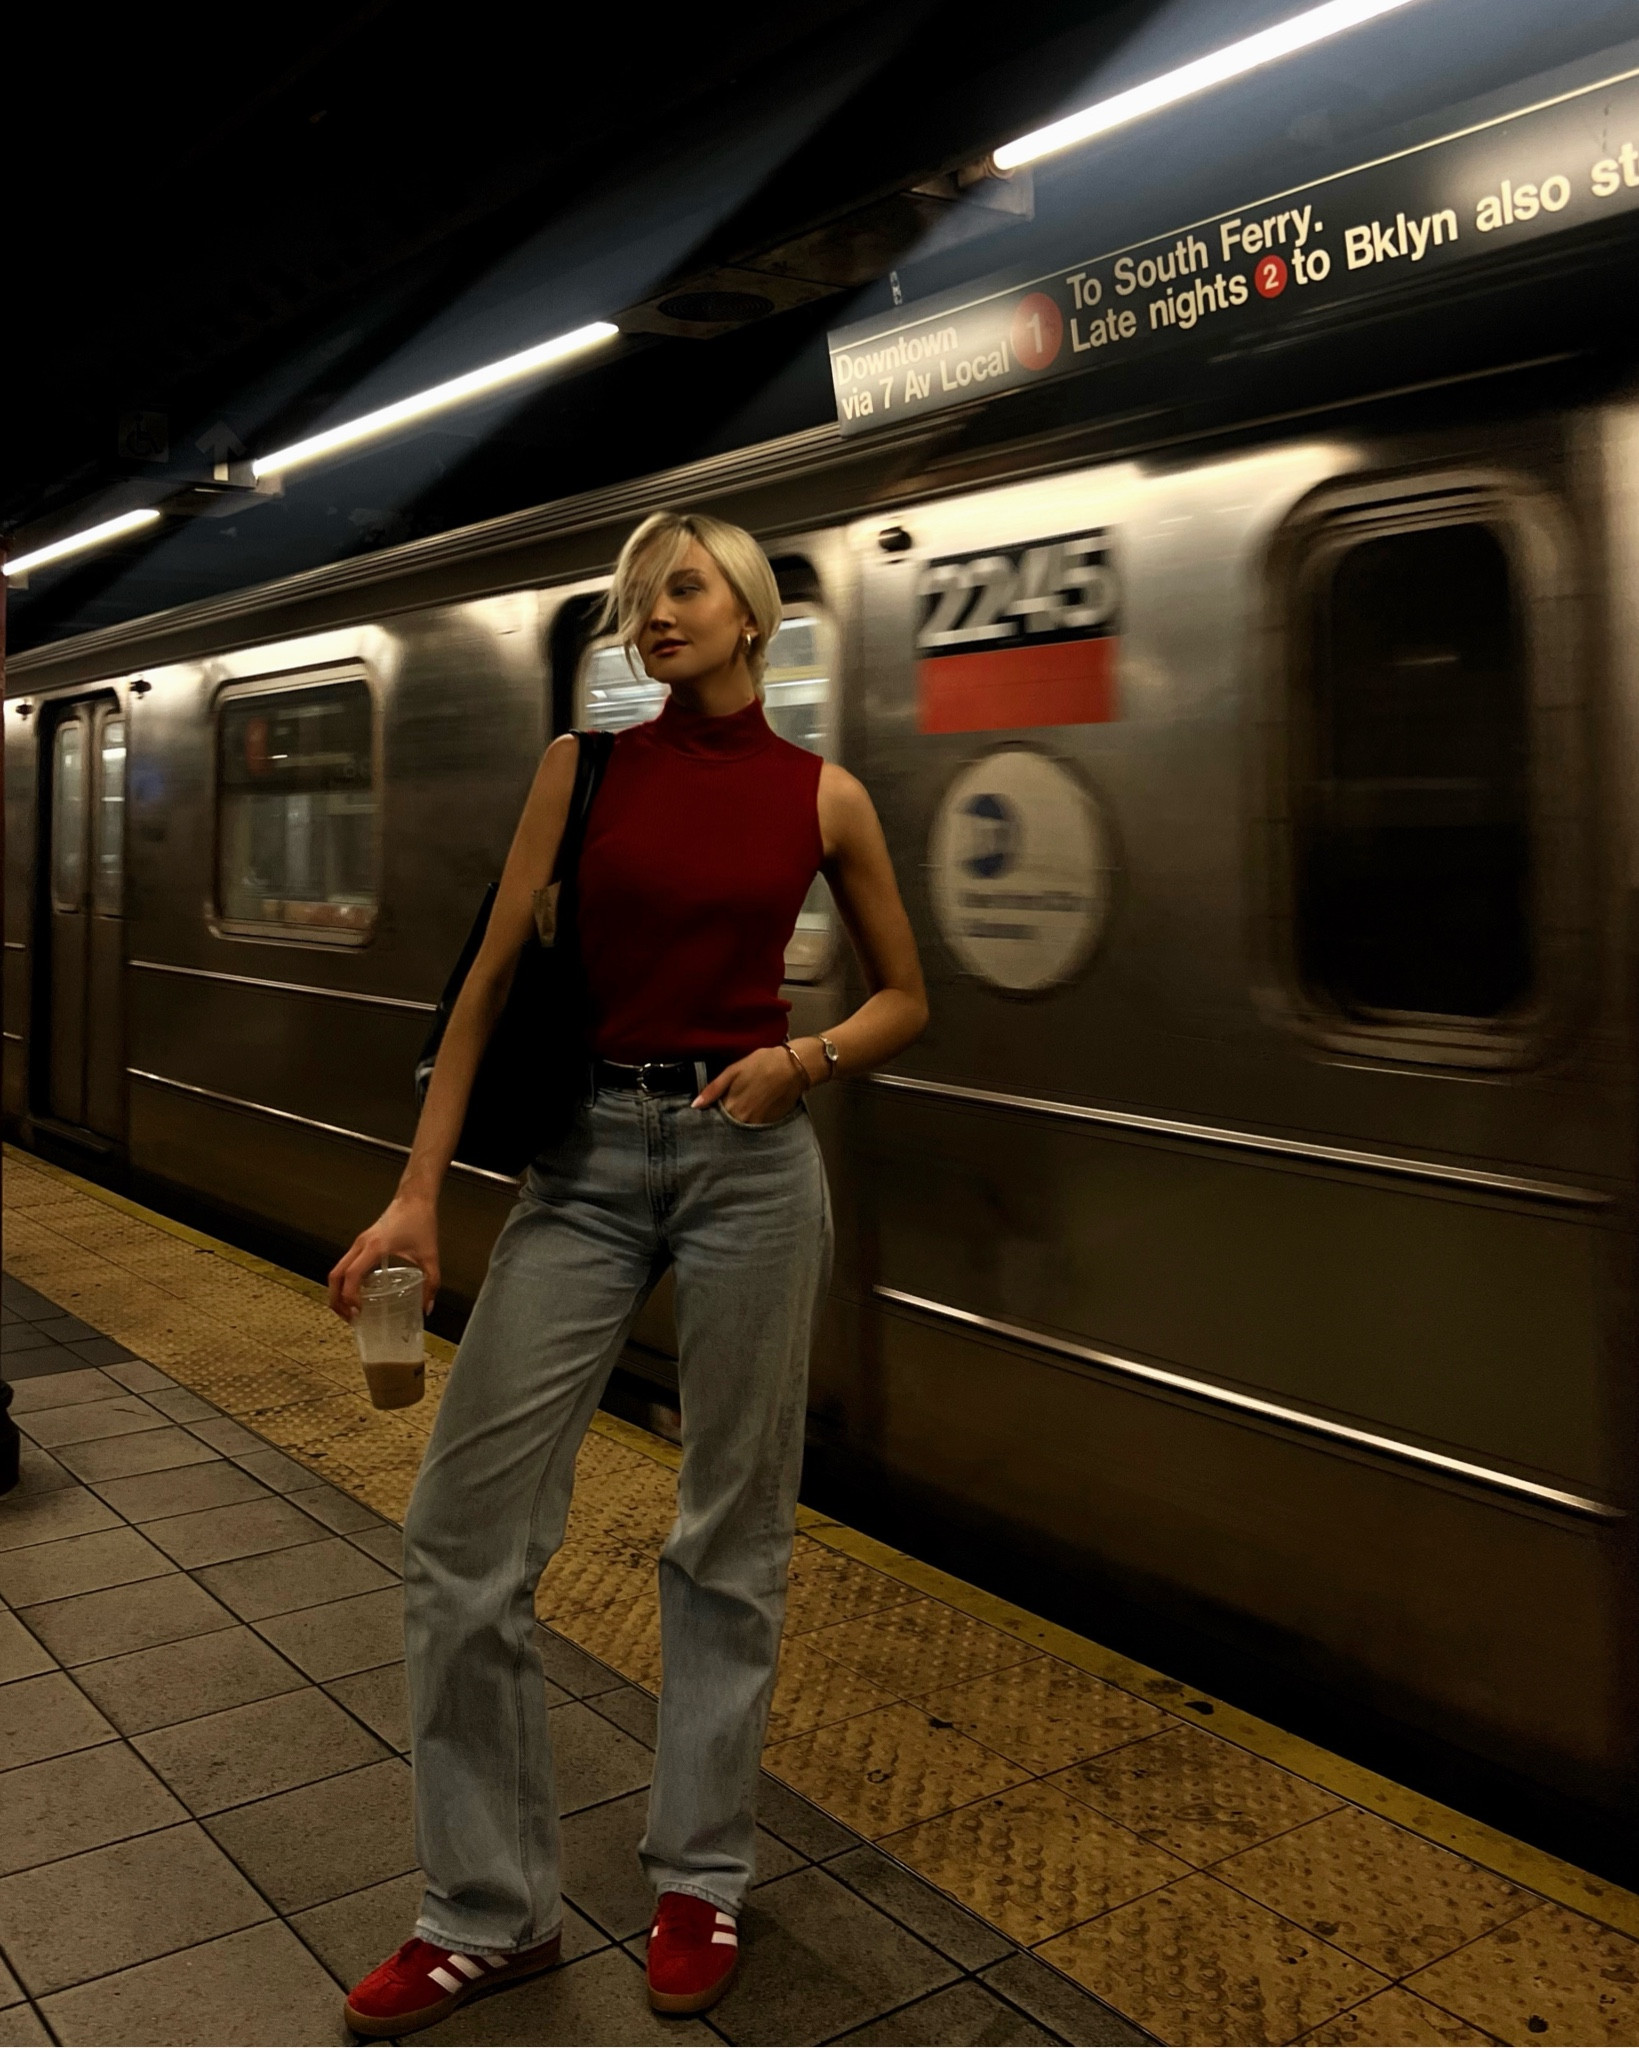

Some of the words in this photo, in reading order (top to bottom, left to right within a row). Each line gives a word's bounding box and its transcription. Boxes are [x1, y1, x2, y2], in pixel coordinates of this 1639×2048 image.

[1066, 272, 1102, 309] To
[1113, 235, 1208, 296] South
[1220, 205, 1323, 262] Ferry.
[1070, 308, 1137, 352] Late
[1149, 273, 1249, 330] nights
[1263, 263, 1279, 290] 2
[1291, 247, 1331, 285] to
[1344, 207, 1458, 271] Bklyn
[1475, 174, 1571, 232] also
[1591, 142, 1639, 197] st
[835, 326, 959, 386] Downtown
[1025, 313, 1042, 353] 1
[841, 387, 874, 420] via
[879, 377, 893, 409] 7
[904, 369, 931, 403] Av
[939, 341, 1010, 391] Local
[915, 535, 1117, 649] 2245
